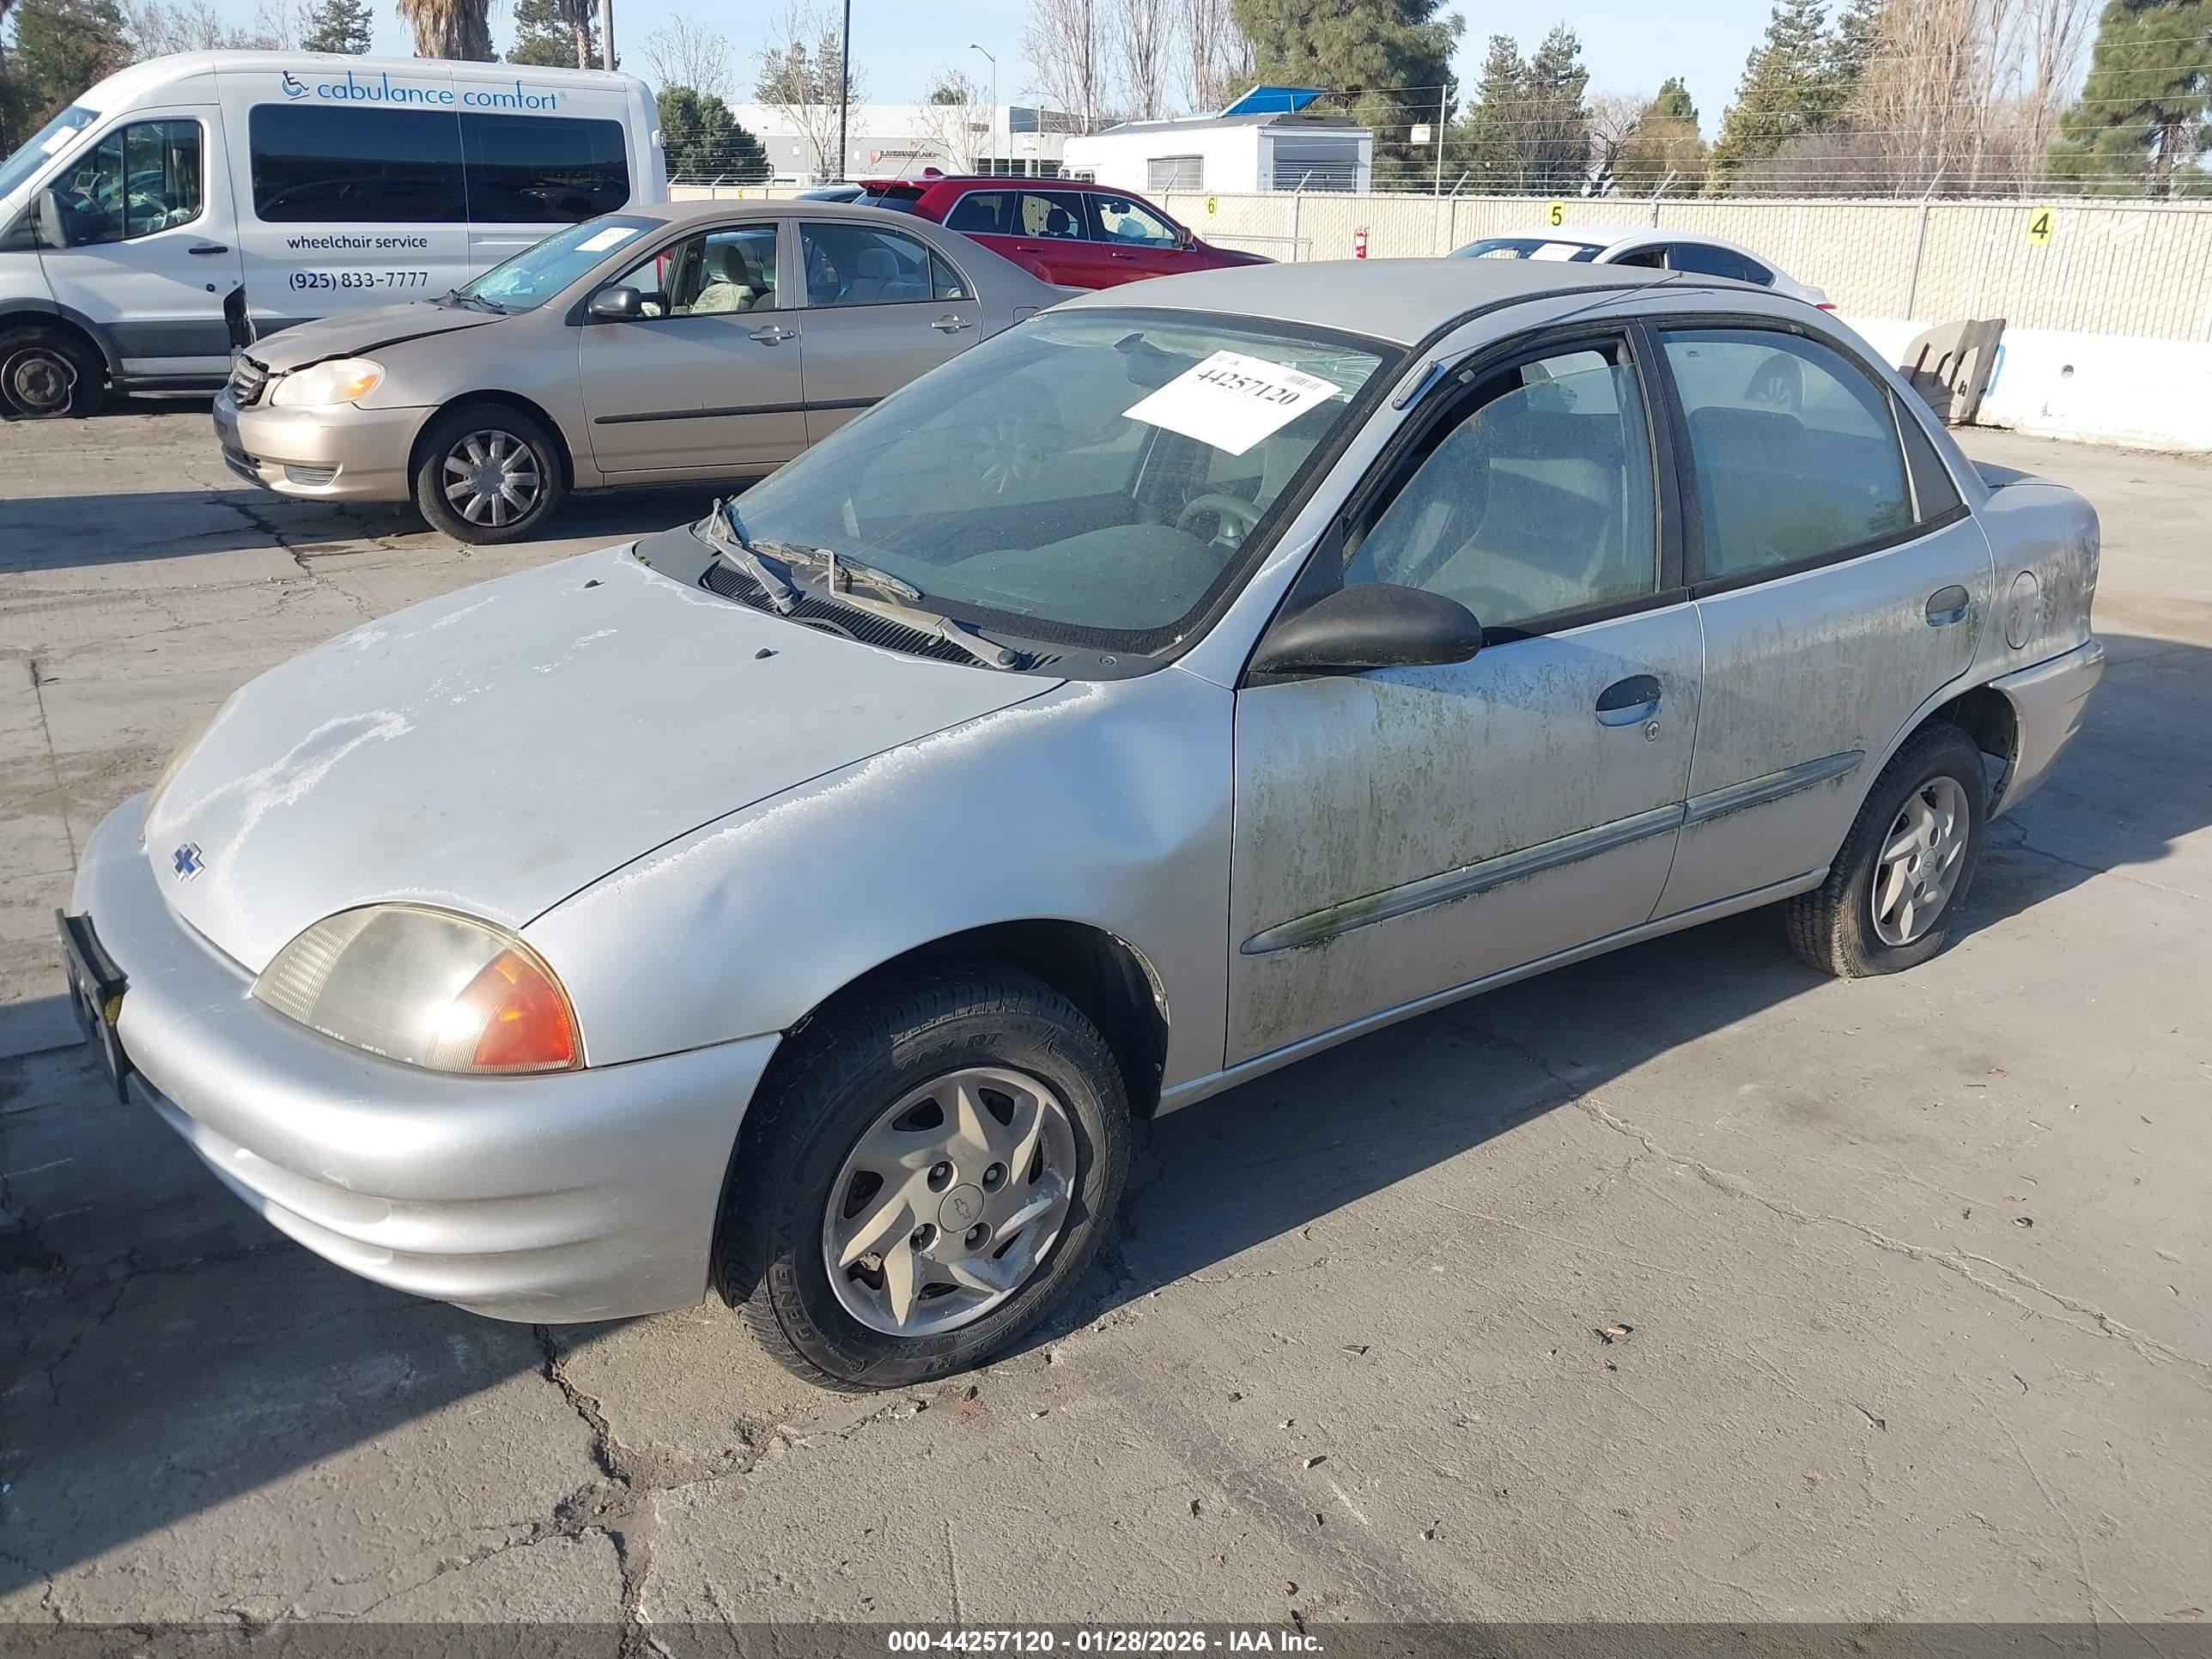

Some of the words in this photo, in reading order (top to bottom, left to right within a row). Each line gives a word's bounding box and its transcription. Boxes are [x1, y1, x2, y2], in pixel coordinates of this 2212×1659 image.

[317, 70, 454, 104] cabulance
[1208, 197, 1215, 214] 6
[1552, 205, 1562, 227] 5
[2031, 212, 2050, 240] 4
[287, 234, 373, 249] wheelchair
[375, 234, 428, 248] service
[289, 272, 337, 291] (925)
[341, 271, 428, 289] 833-7777
[1197, 368, 1300, 406] 44257120
